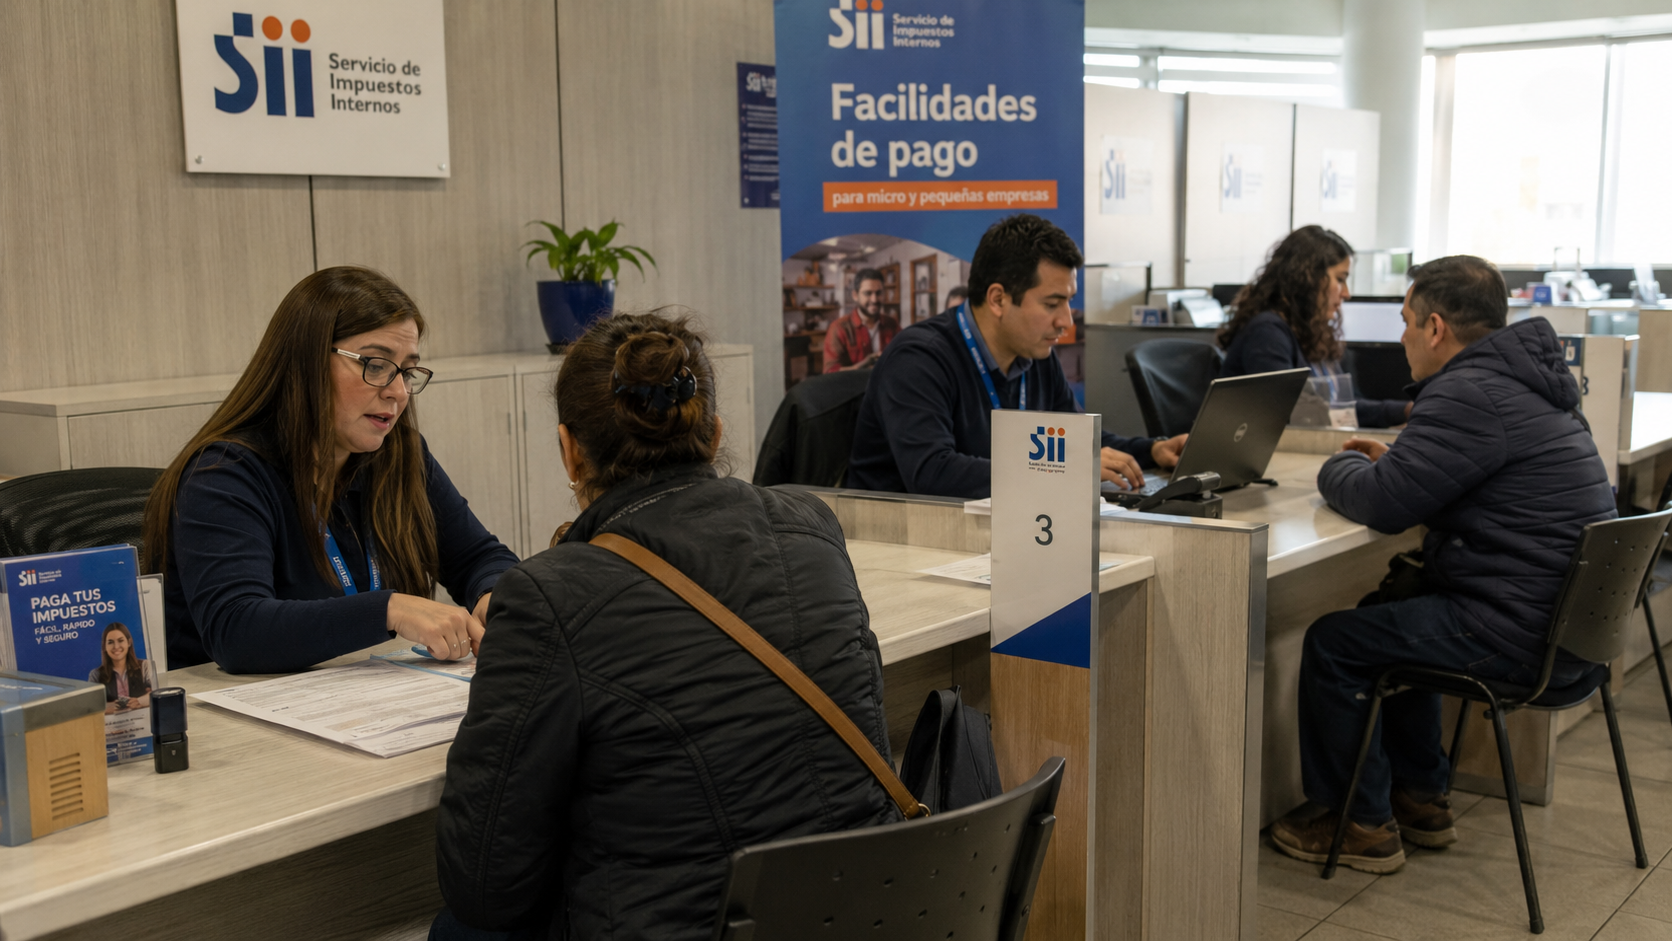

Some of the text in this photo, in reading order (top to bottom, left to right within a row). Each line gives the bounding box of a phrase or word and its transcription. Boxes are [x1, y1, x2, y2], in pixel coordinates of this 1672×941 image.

[828, 0, 885, 49] Sii
[893, 13, 955, 26] Servicio de
[893, 25, 955, 37] Impuestos
[893, 37, 941, 48] Internos
[214, 12, 314, 118] Sii
[329, 53, 421, 76] Servicio de
[330, 73, 421, 95] Impuestos
[331, 93, 401, 114] Internos
[831, 83, 1037, 122] Facilidades
[831, 130, 978, 177] de pago
[832, 188, 1049, 207] para micro y pequeñas empresas
[1029, 426, 1065, 462] Sii
[1035, 514, 1053, 546] 3
[31, 588, 101, 610] PAGA TUS
[32, 600, 116, 624] IMPUESTOS
[35, 631, 79, 645] Y SEGURO
